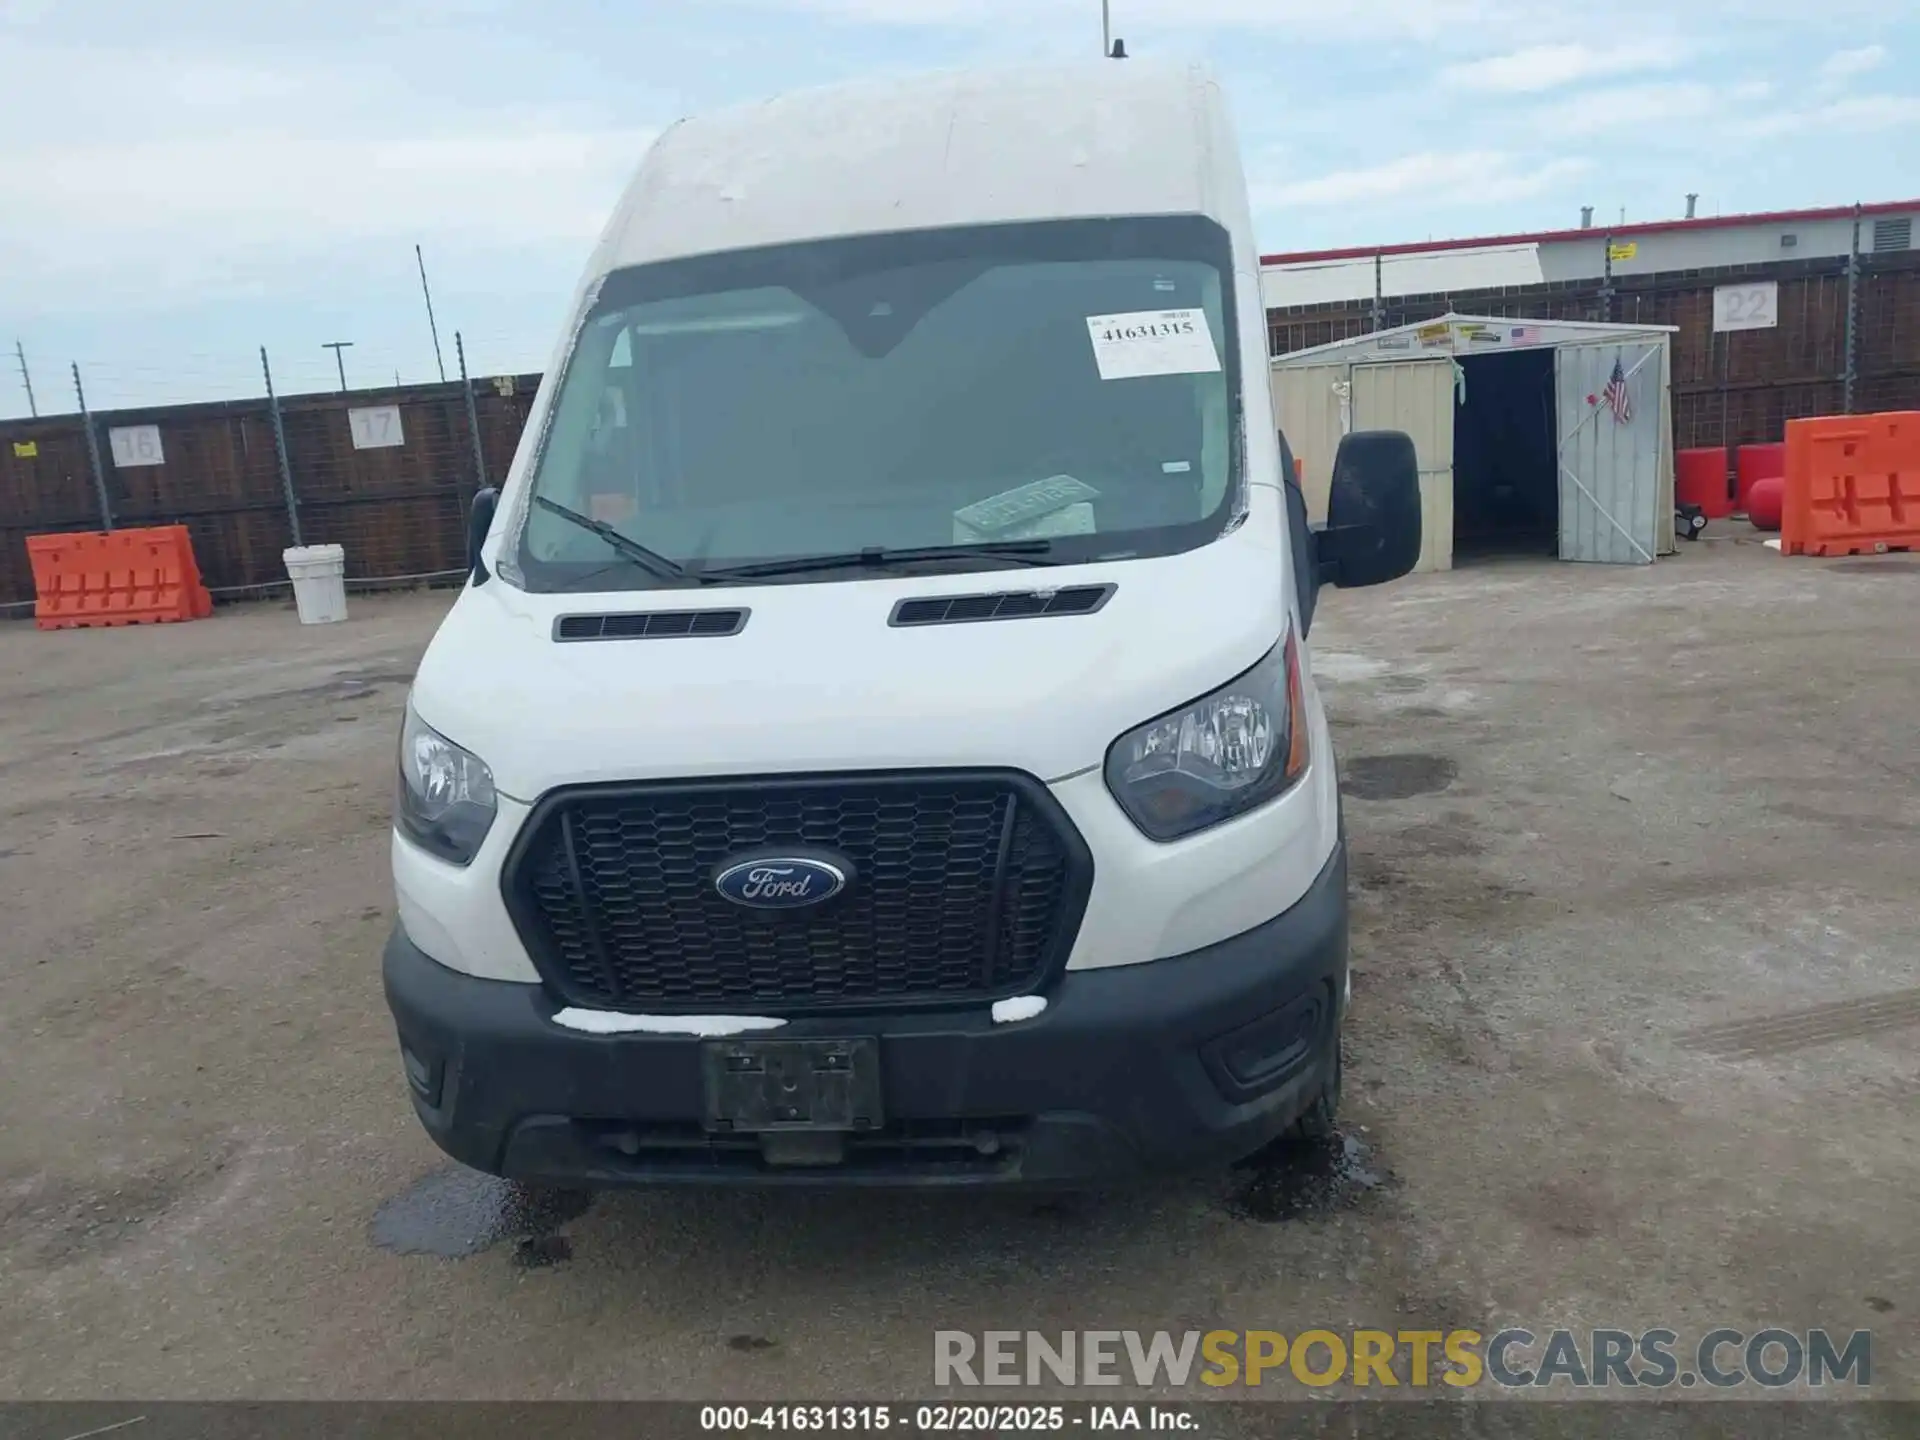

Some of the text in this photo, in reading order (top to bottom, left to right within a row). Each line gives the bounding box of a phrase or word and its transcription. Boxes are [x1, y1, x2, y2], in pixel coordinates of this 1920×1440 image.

[1724, 289, 1768, 322] 22
[1102, 322, 1194, 341] 41631315
[360, 411, 391, 441] 17
[120, 431, 154, 459] 16
[742, 868, 811, 898] Ford
